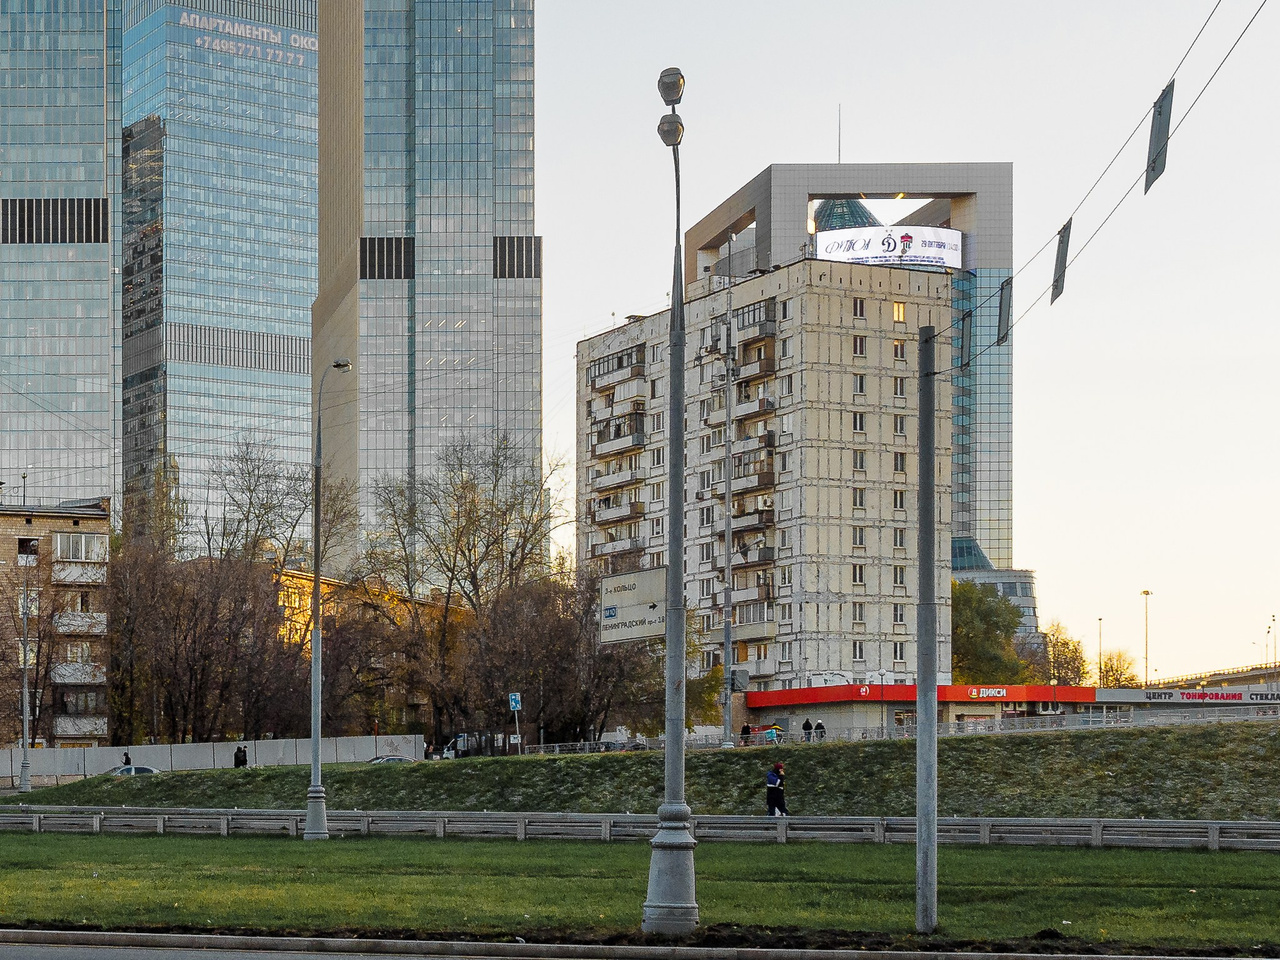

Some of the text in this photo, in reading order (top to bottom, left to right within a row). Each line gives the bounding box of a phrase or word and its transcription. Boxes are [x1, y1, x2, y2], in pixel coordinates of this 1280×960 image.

[180, 11, 318, 51] АПАРТАМЕНТЫ ОКО
[613, 583, 637, 593] КОЛЬЦО
[602, 617, 647, 631] ЛЕНИНГРАДСКИЙ
[979, 688, 1007, 697] ДИКСИ
[1145, 692, 1174, 700] ЦЕНТР
[1180, 692, 1243, 700] ТОНИРОВАНИЯ
